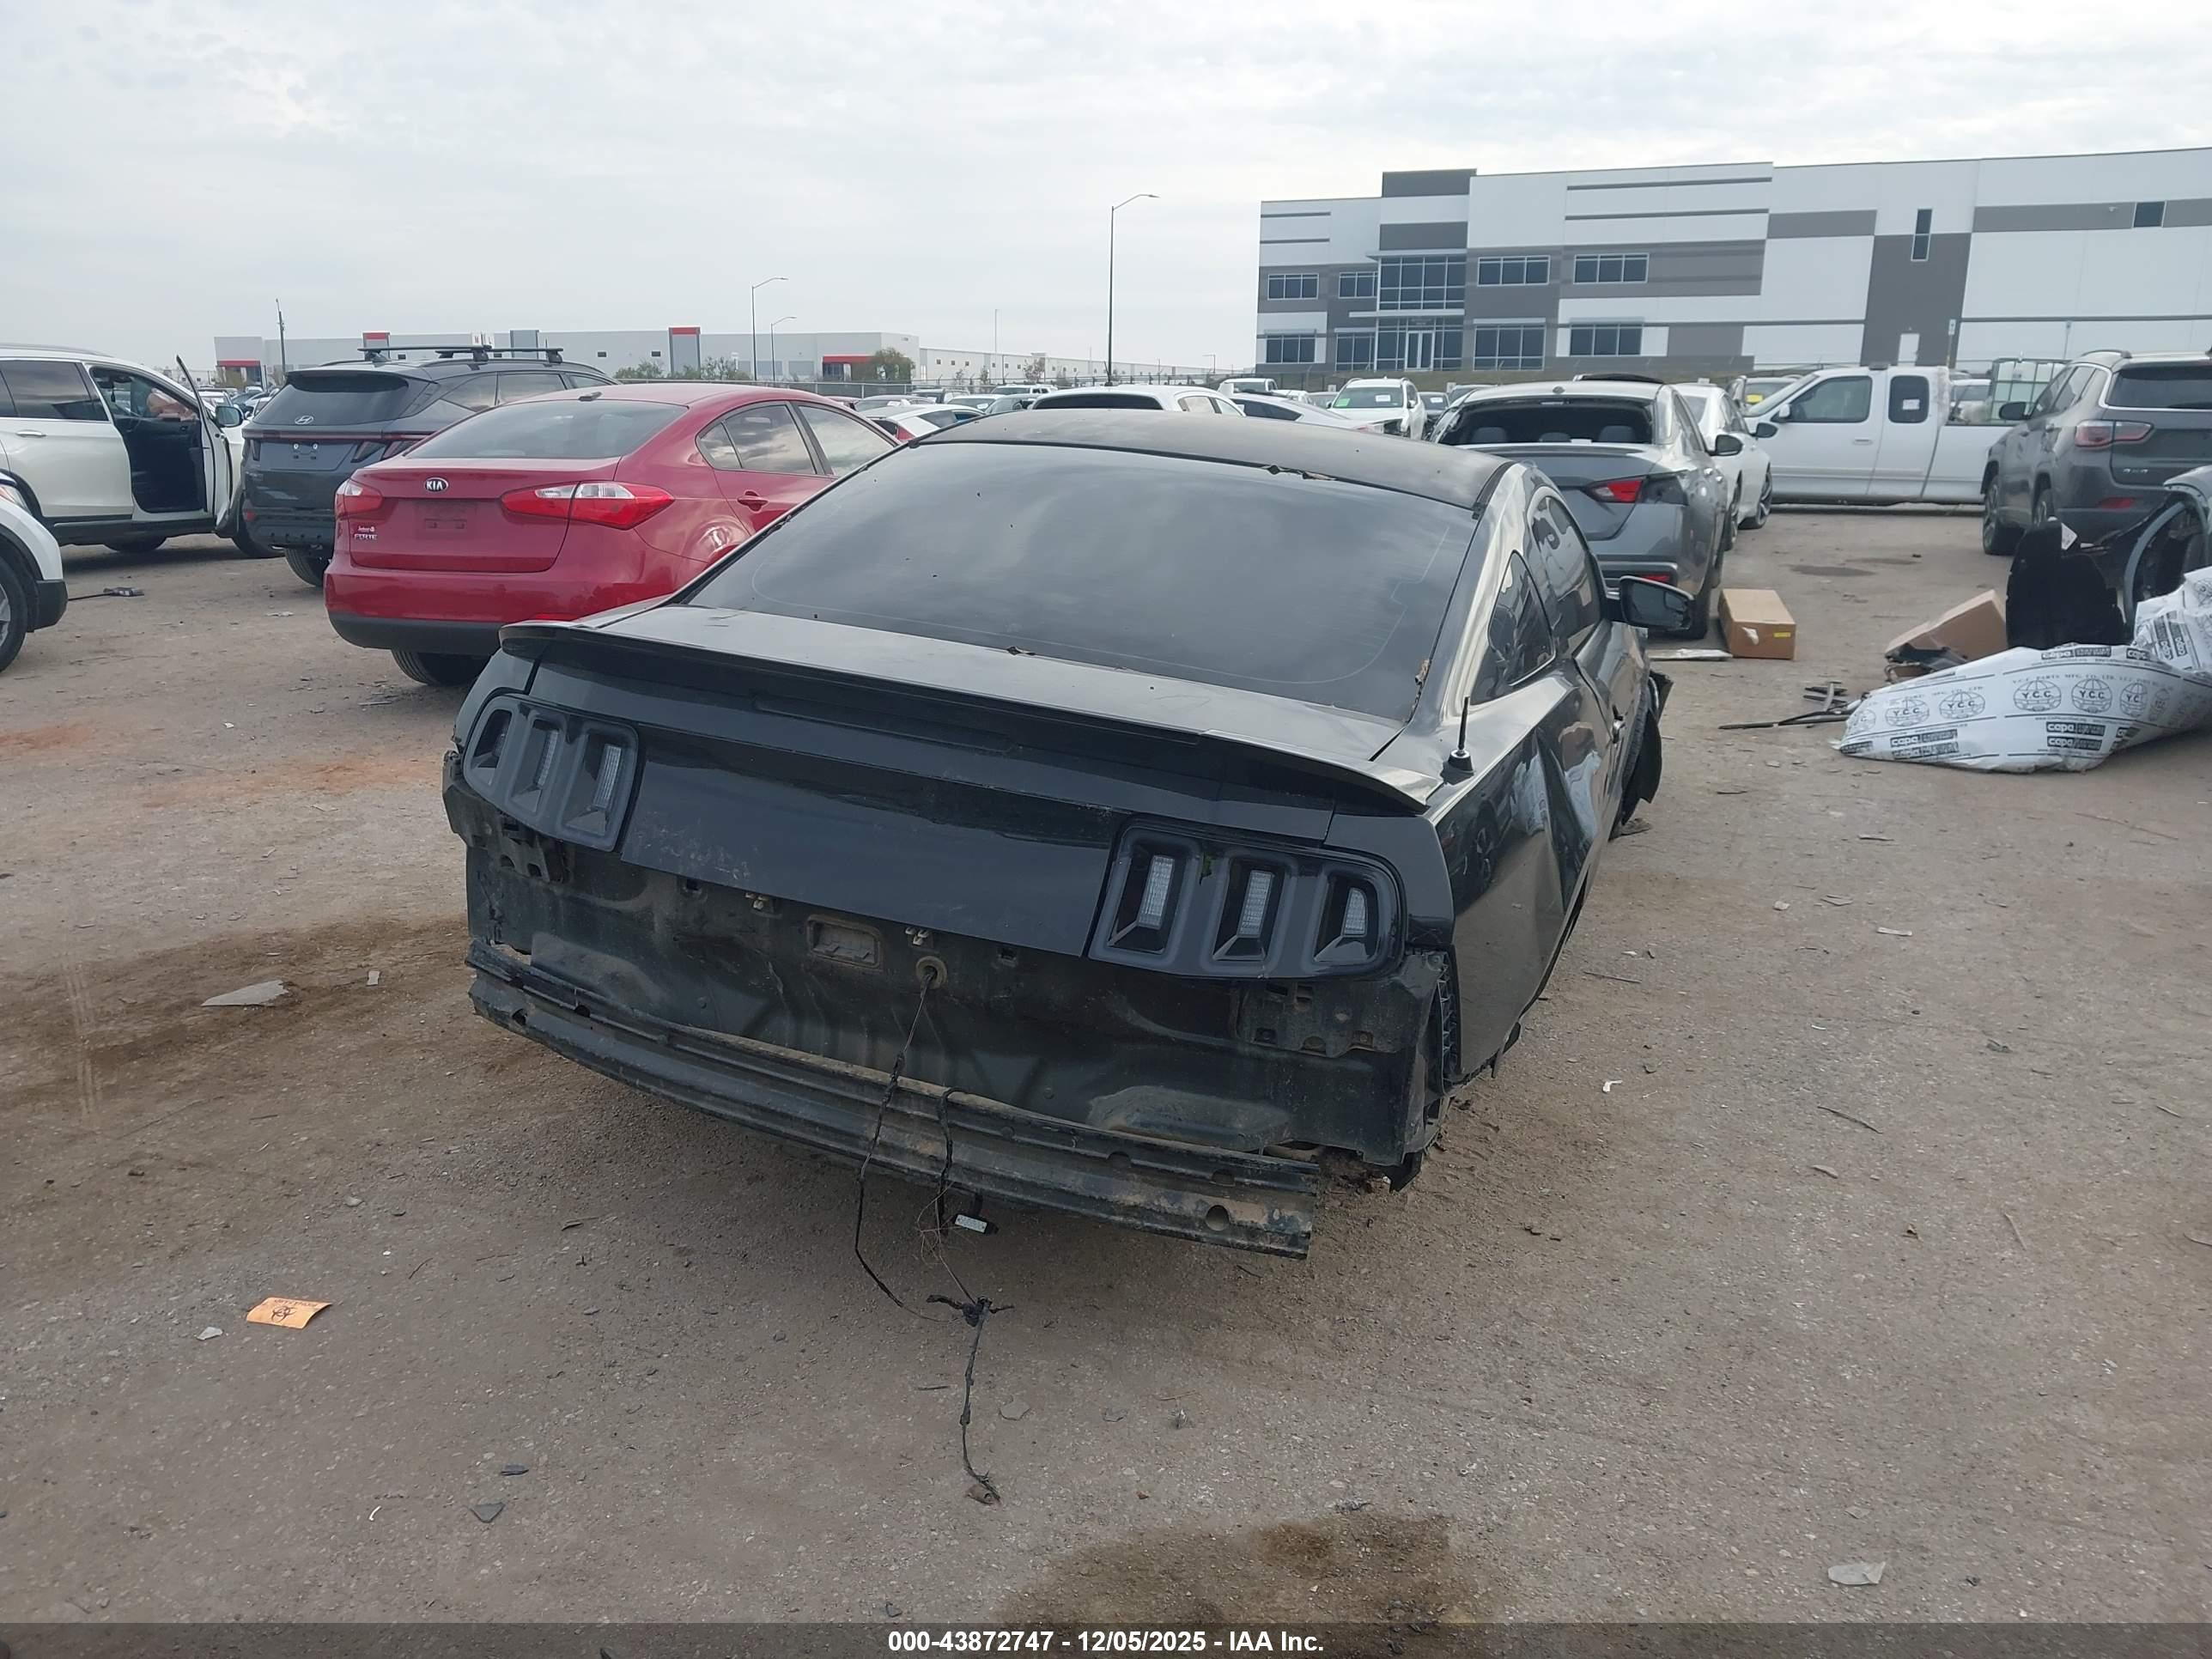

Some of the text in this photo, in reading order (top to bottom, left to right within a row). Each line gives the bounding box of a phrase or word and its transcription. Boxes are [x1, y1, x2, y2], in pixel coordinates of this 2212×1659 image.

[427, 481, 443, 490] KIA
[2048, 723, 2075, 732] capa
[1892, 736, 1919, 746] capa
[2049, 738, 2074, 747] capa
